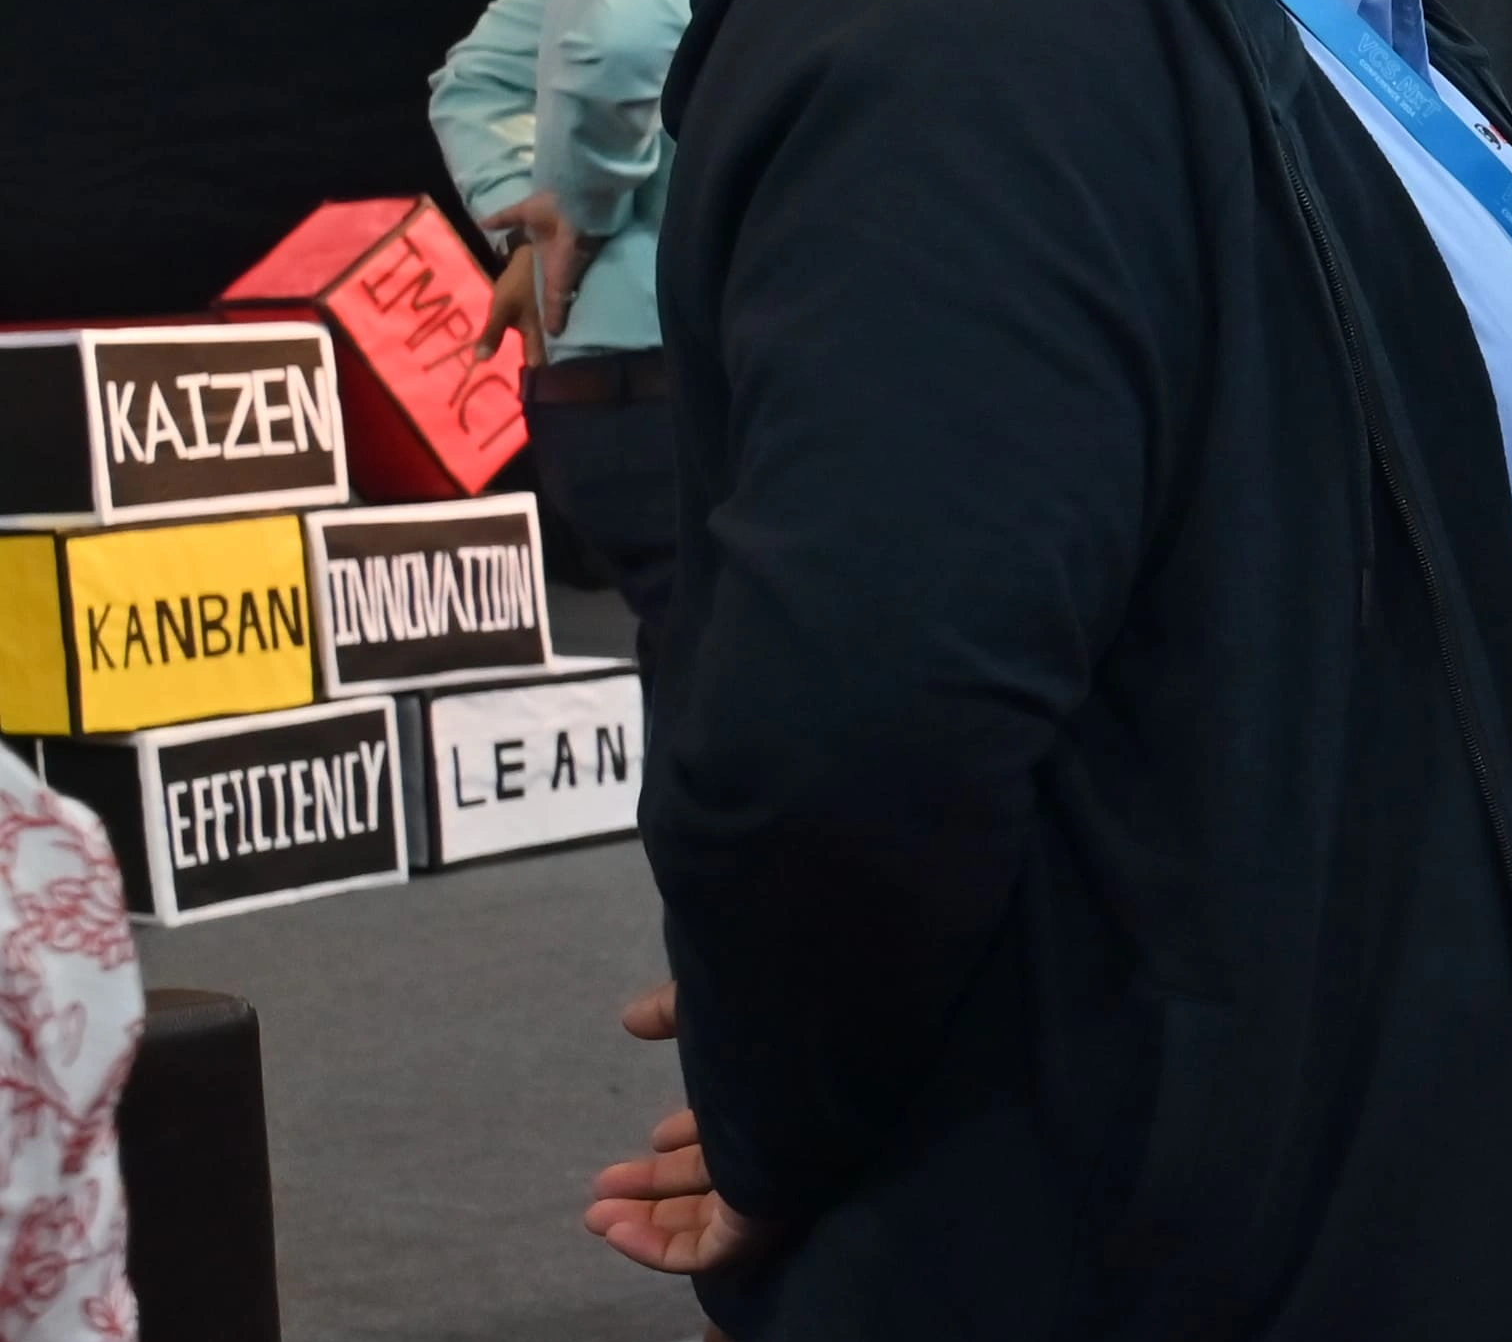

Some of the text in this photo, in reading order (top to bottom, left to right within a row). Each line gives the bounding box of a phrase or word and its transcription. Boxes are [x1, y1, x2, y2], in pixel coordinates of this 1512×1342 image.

[107, 366, 334, 463] KAIZEN
[87, 585, 306, 672] KANBAN
[327, 544, 538, 646] INNOVATION
[166, 739, 388, 869] EFFICIENCY
[451, 723, 628, 808] LEAN
